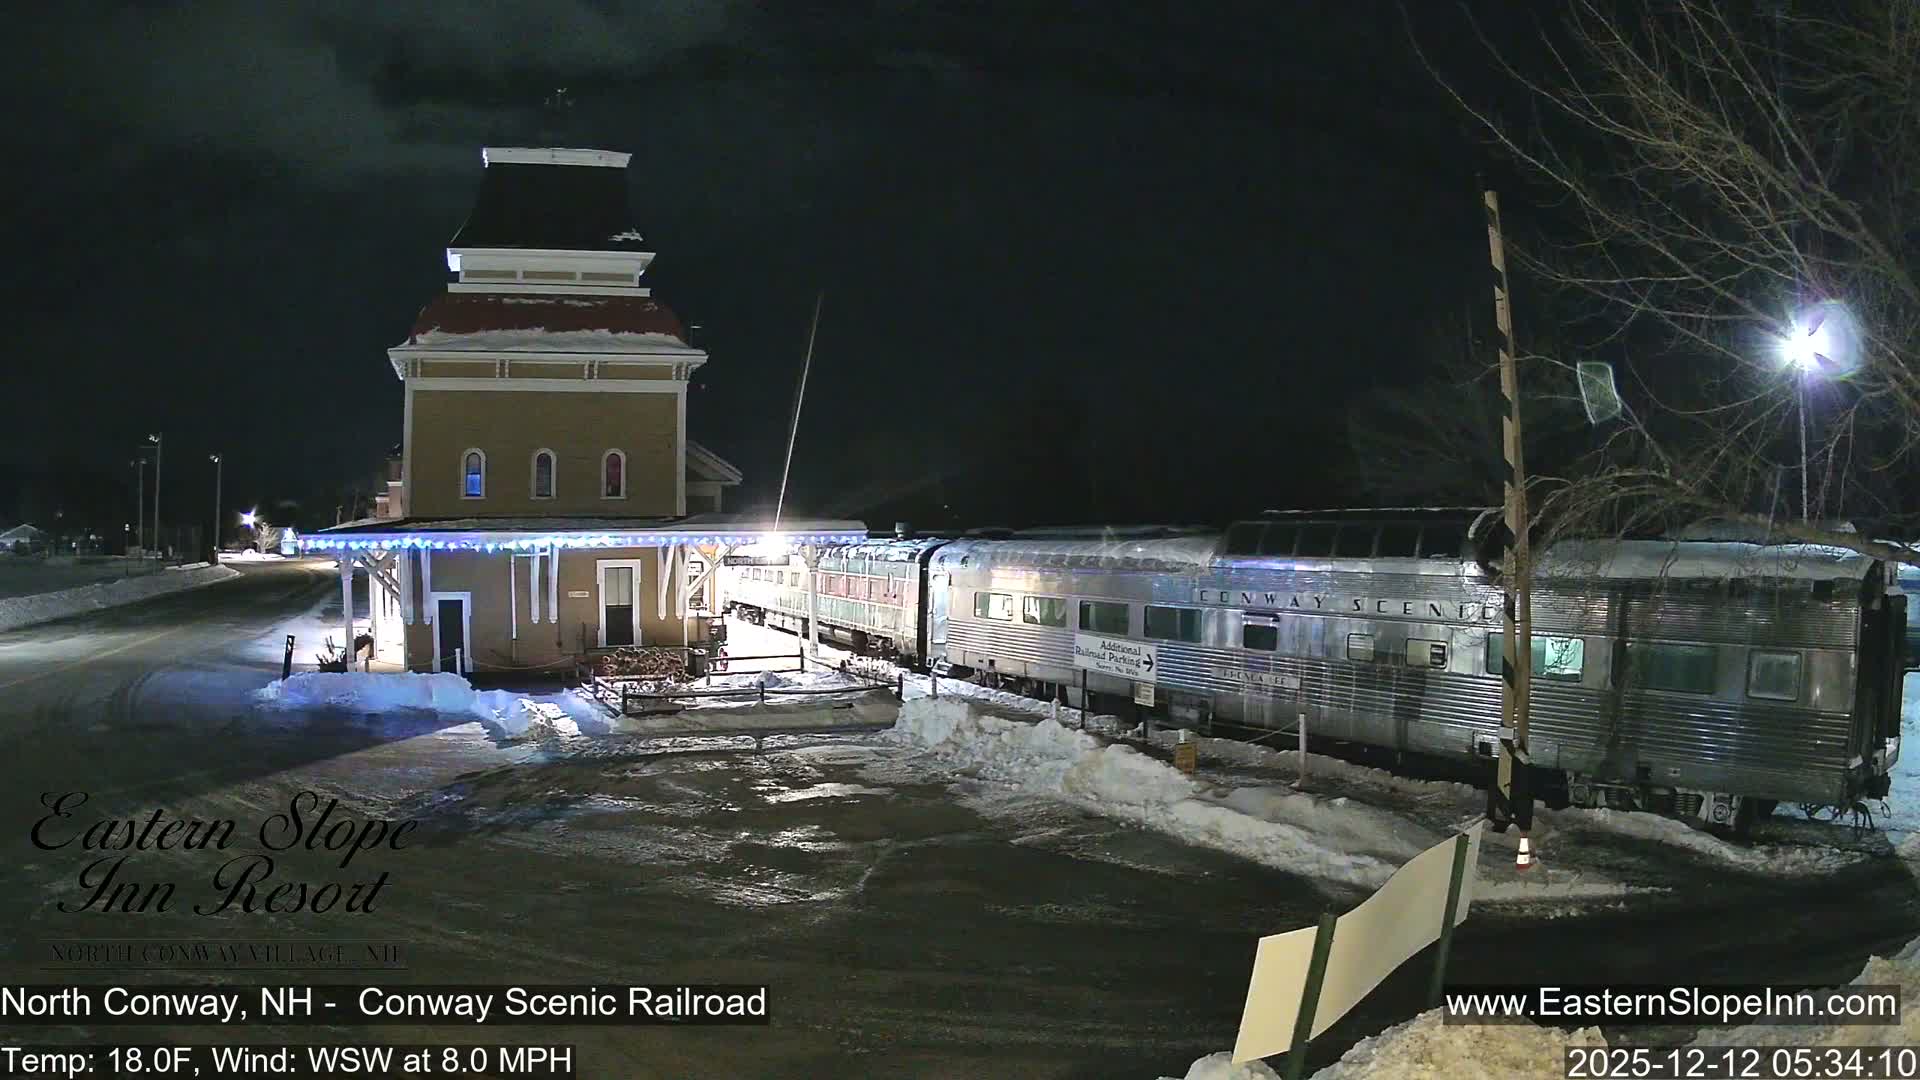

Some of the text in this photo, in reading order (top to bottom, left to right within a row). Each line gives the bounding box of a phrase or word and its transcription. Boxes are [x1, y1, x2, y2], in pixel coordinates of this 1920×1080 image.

[1200, 590, 1496, 620] CONWAY SCENIC
[1075, 646, 1141, 668] Railroad Parking
[1100, 641, 1141, 656] Additional
